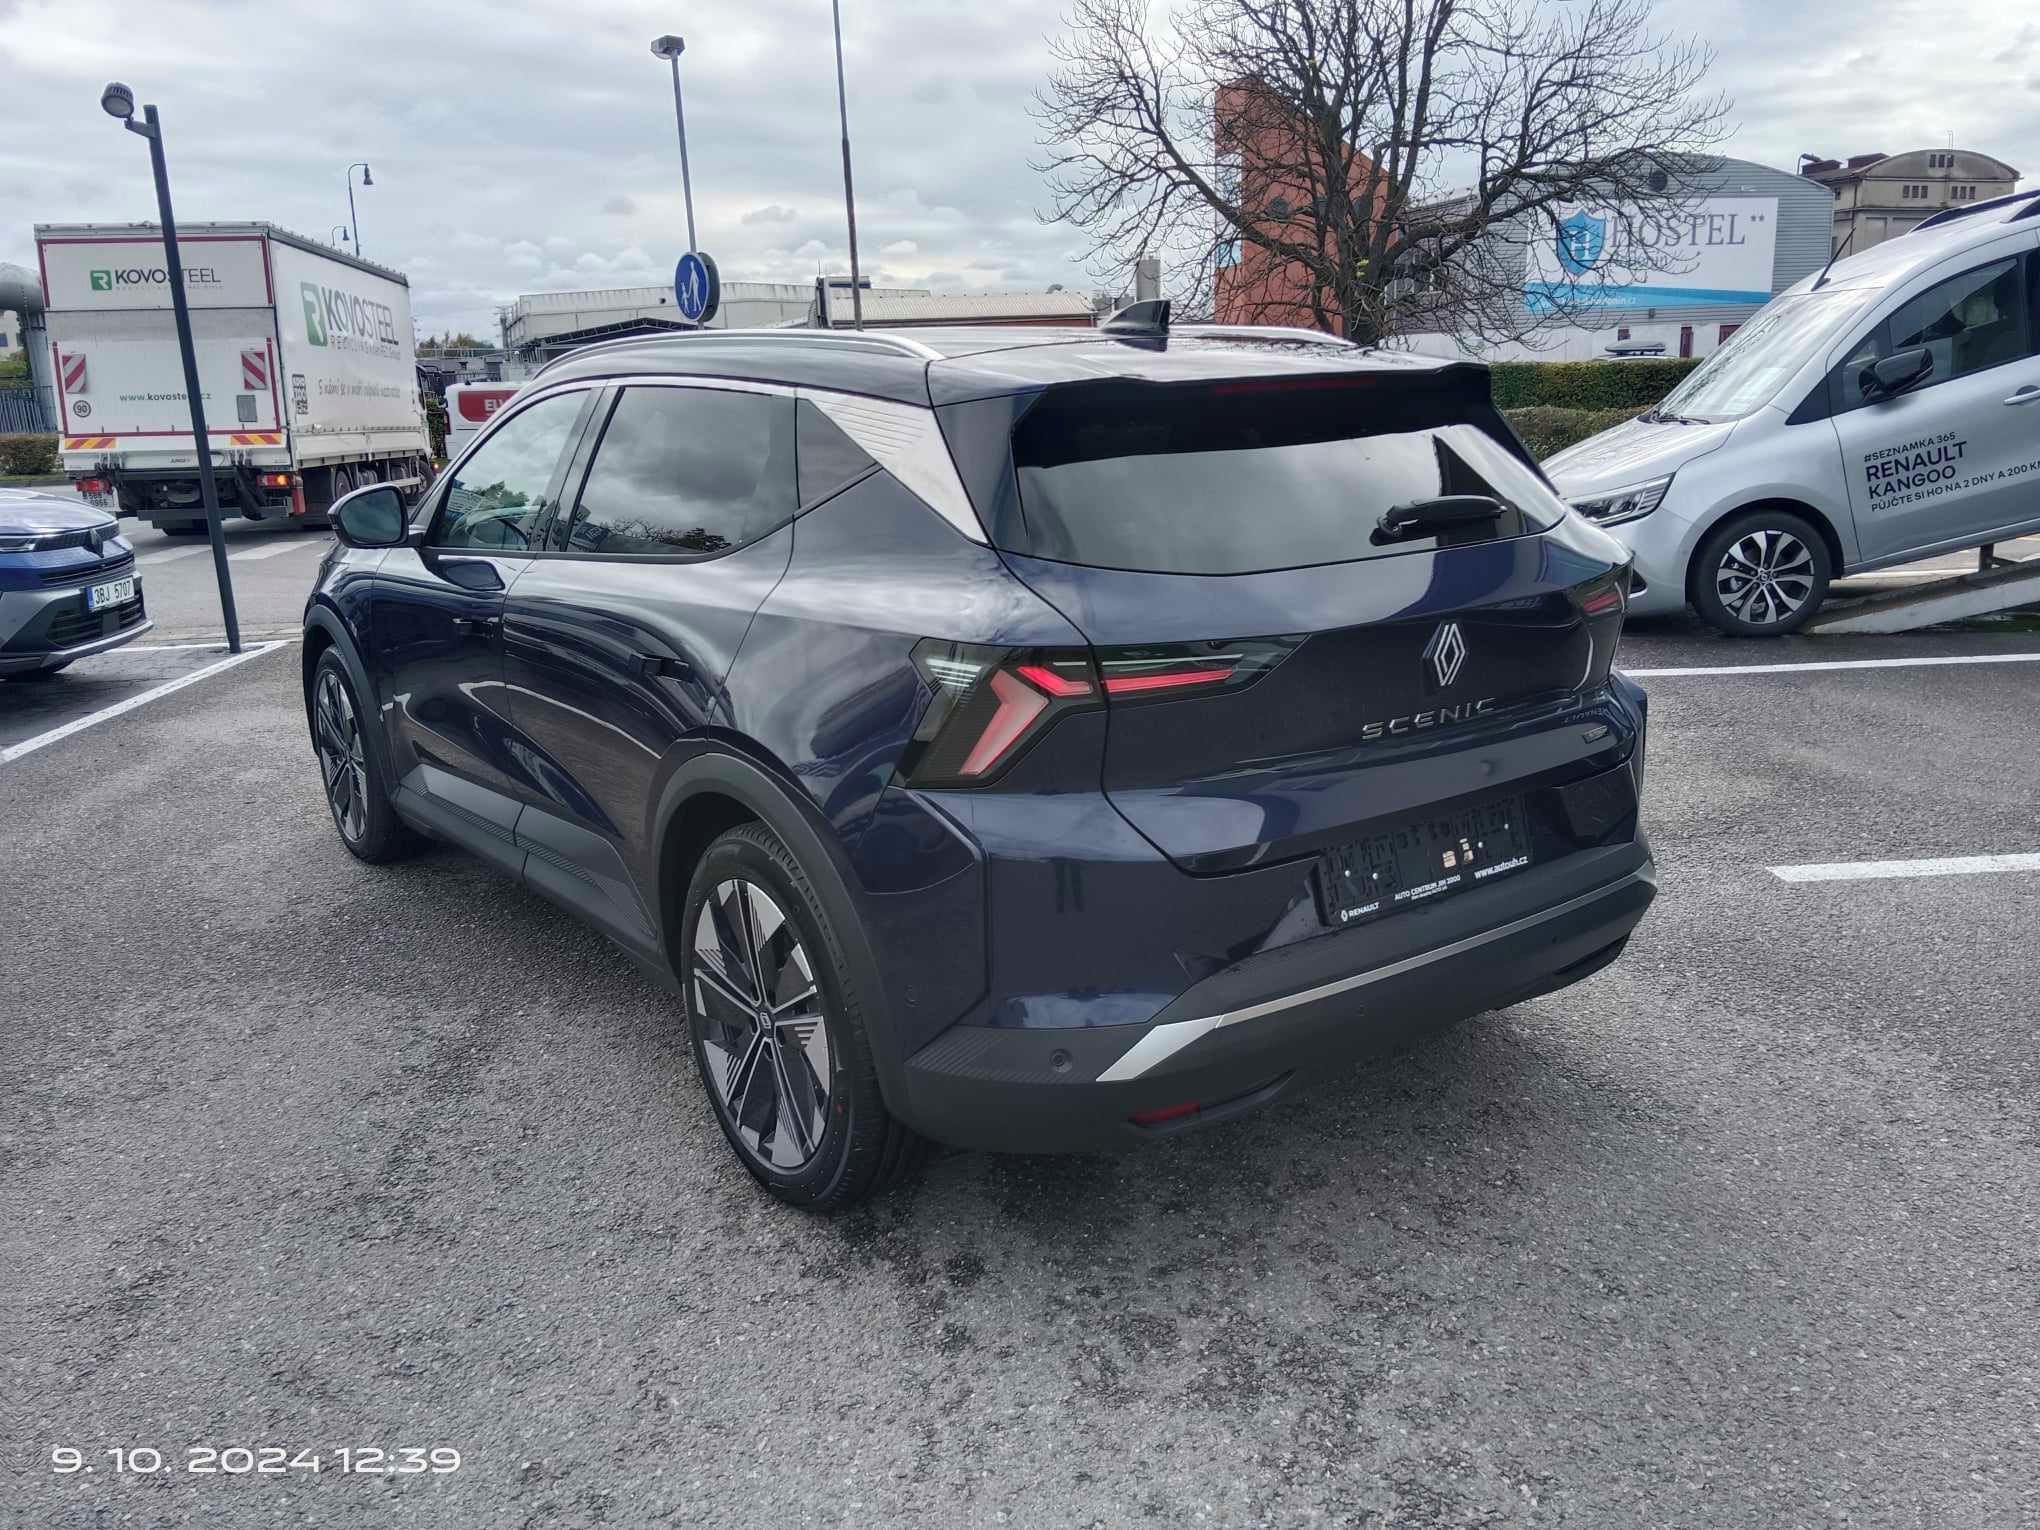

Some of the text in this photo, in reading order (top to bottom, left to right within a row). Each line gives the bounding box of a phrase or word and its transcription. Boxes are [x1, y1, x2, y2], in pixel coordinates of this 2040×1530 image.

[1609, 214, 1746, 247] HOSTEL
[320, 286, 399, 346] KOVOSTEEL
[1864, 431, 1956, 462] #SEZNAMKA 365
[1865, 440, 1967, 482] RENAULT
[1868, 465, 1956, 499] KANGOO
[1871, 494, 1913, 512] PŮJČTE
[1914, 490, 1925, 501] SI
[1926, 486, 1943, 498] HO
[1945, 482, 1961, 492] NA
[1963, 479, 1970, 488] 2
[1971, 472, 1995, 486] DNY
[1998, 470, 2006, 479] A
[2007, 464, 2028, 477] 200
[1360, 697, 1498, 740] SCENIC
[1348, 901, 1381, 918] RENAULT
[1394, 890, 1411, 901] AUTO
